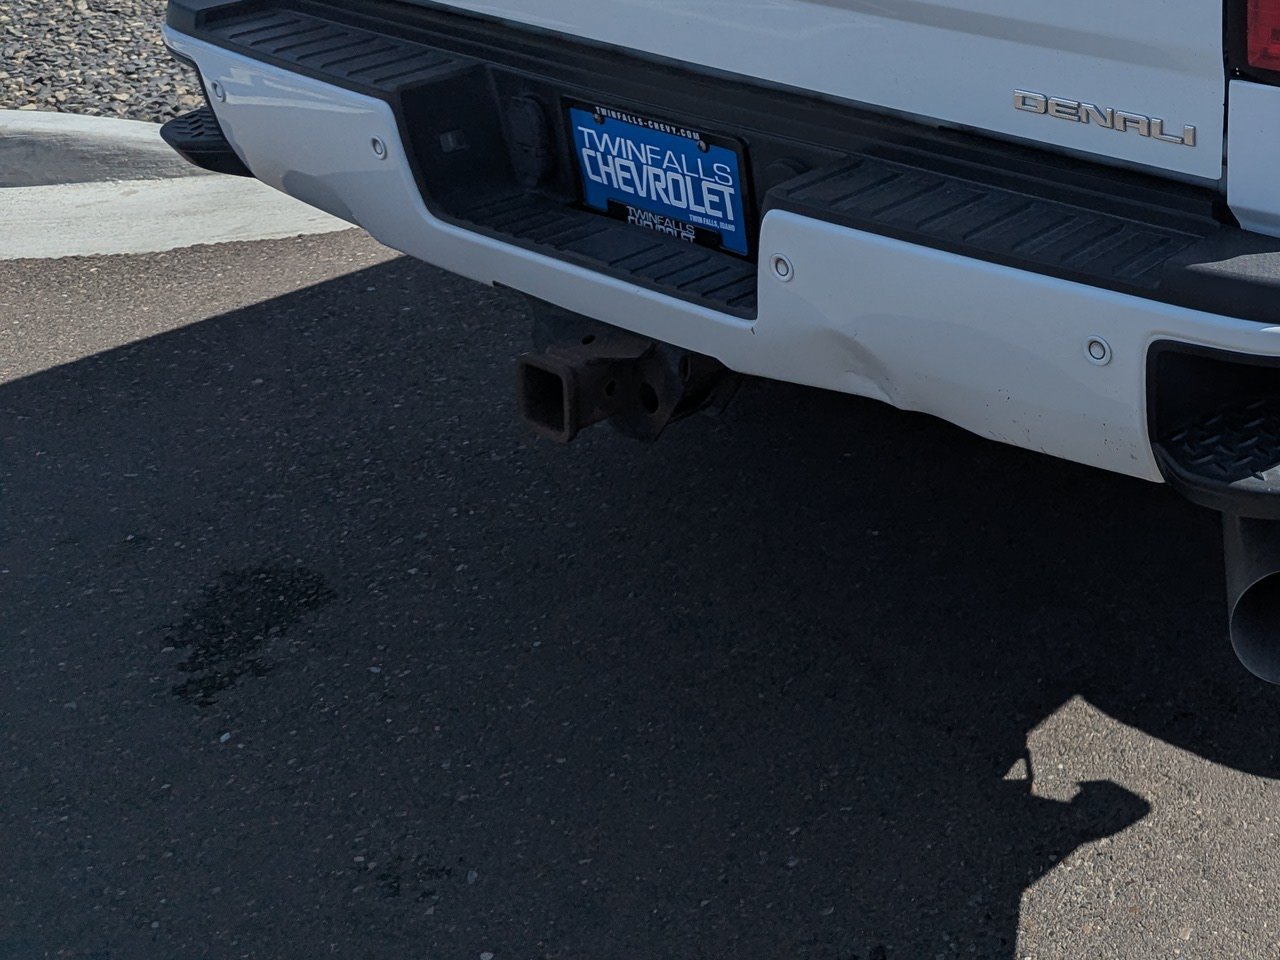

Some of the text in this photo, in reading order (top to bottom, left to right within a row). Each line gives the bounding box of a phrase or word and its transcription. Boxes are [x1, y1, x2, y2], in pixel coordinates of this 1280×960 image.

[594, 106, 701, 141] TWINFALLS-CHEVY.COM
[1014, 88, 1196, 147] DENALI
[577, 126, 733, 186] TWINFALLS
[582, 147, 735, 221] CHEVROLET
[626, 206, 695, 235] TWINFALLS
